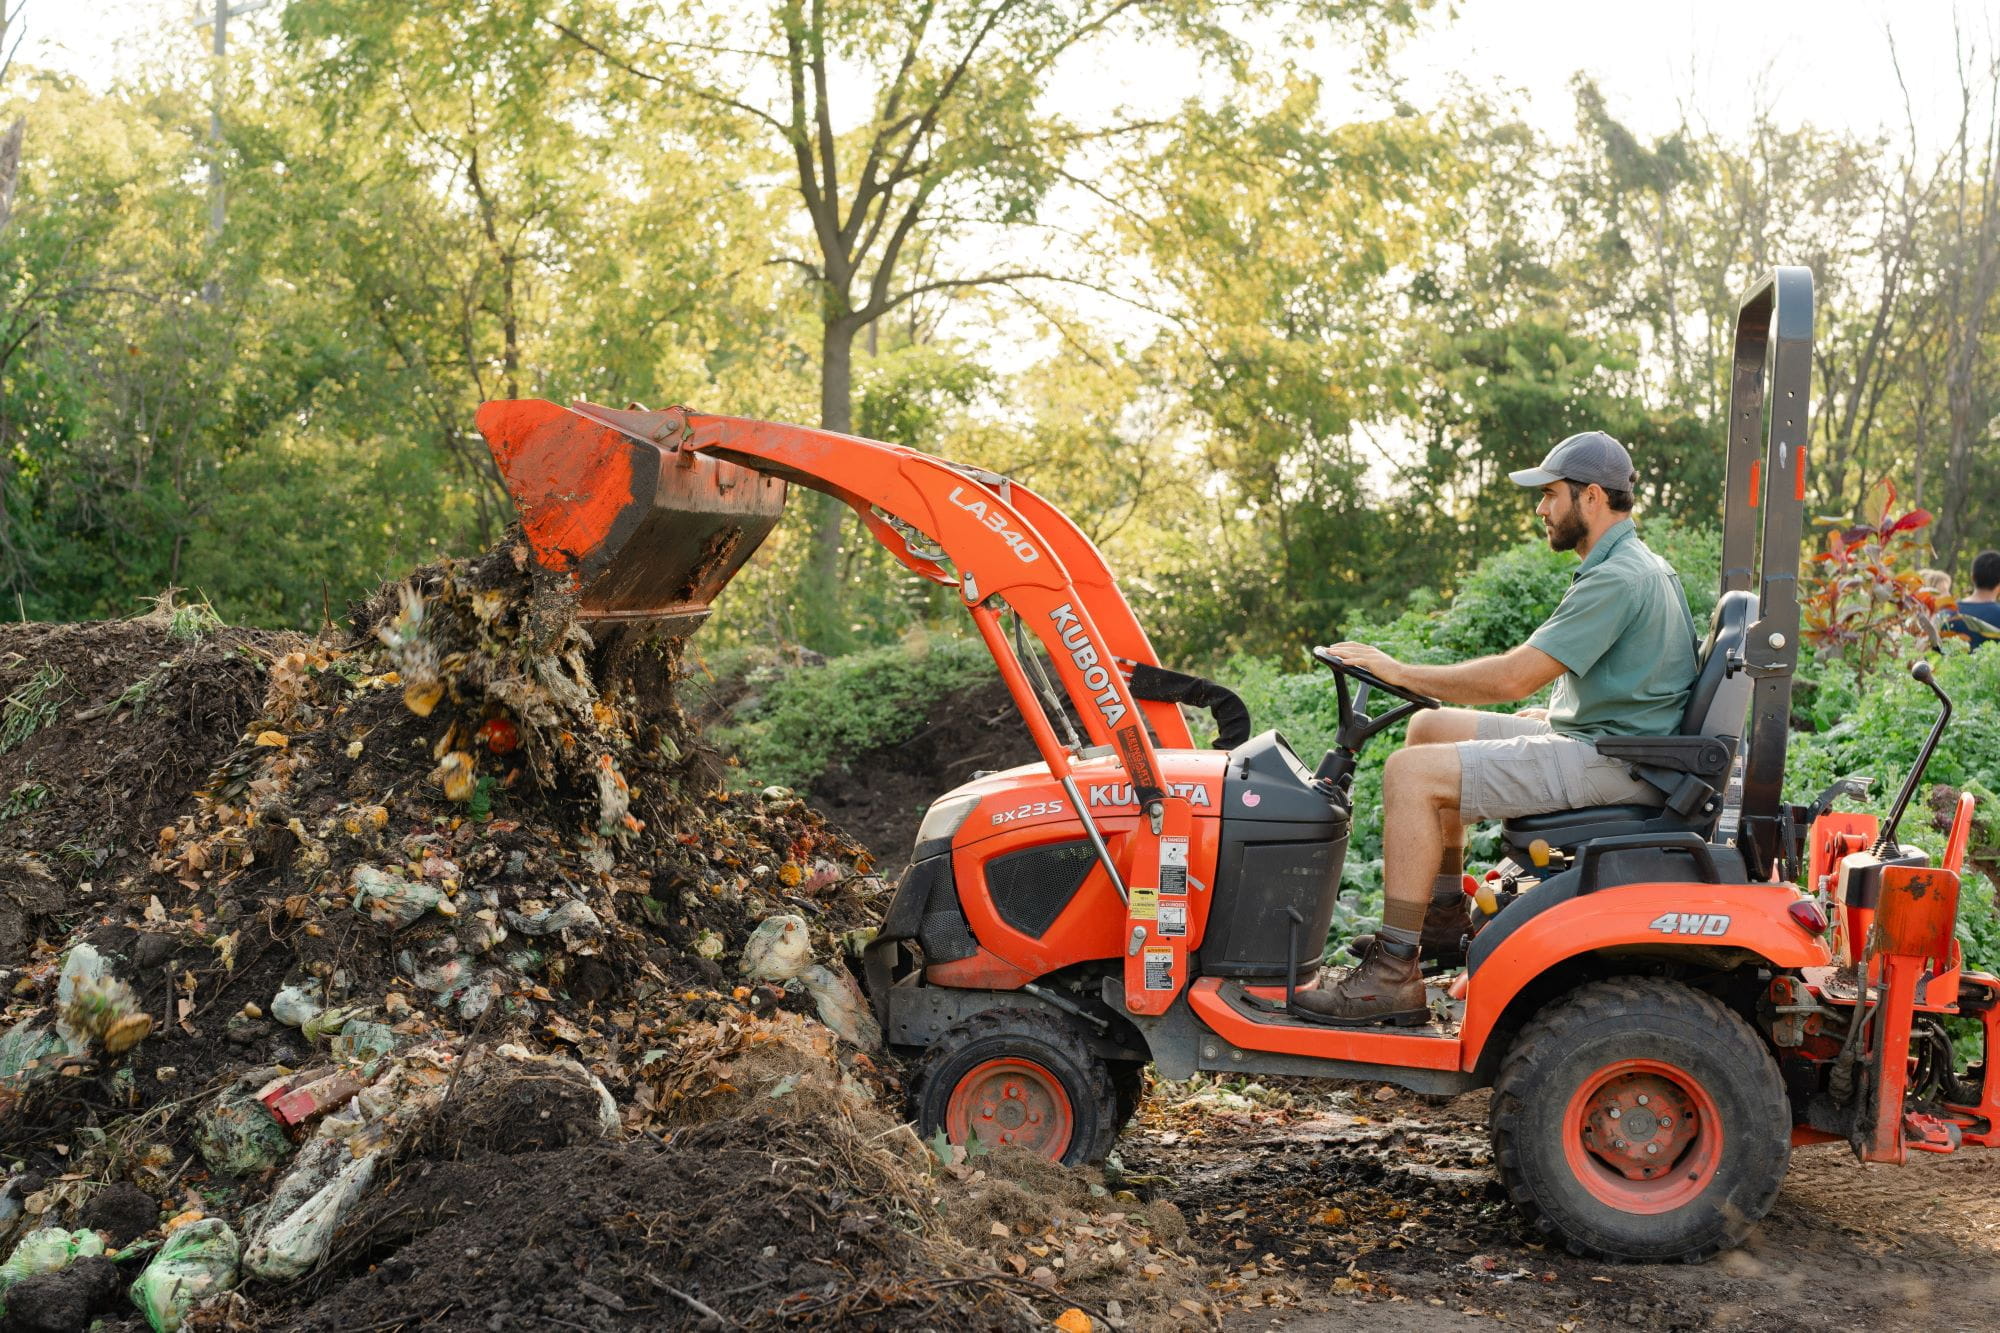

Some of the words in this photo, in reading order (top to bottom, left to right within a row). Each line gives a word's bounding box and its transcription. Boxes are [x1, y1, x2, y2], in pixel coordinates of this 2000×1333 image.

[949, 486, 1040, 563] LA340
[1049, 603, 1127, 729] KUBOTA
[1090, 783, 1210, 806] KUTA
[992, 800, 1063, 826] BX23S
[1648, 912, 1731, 936] 4WD
